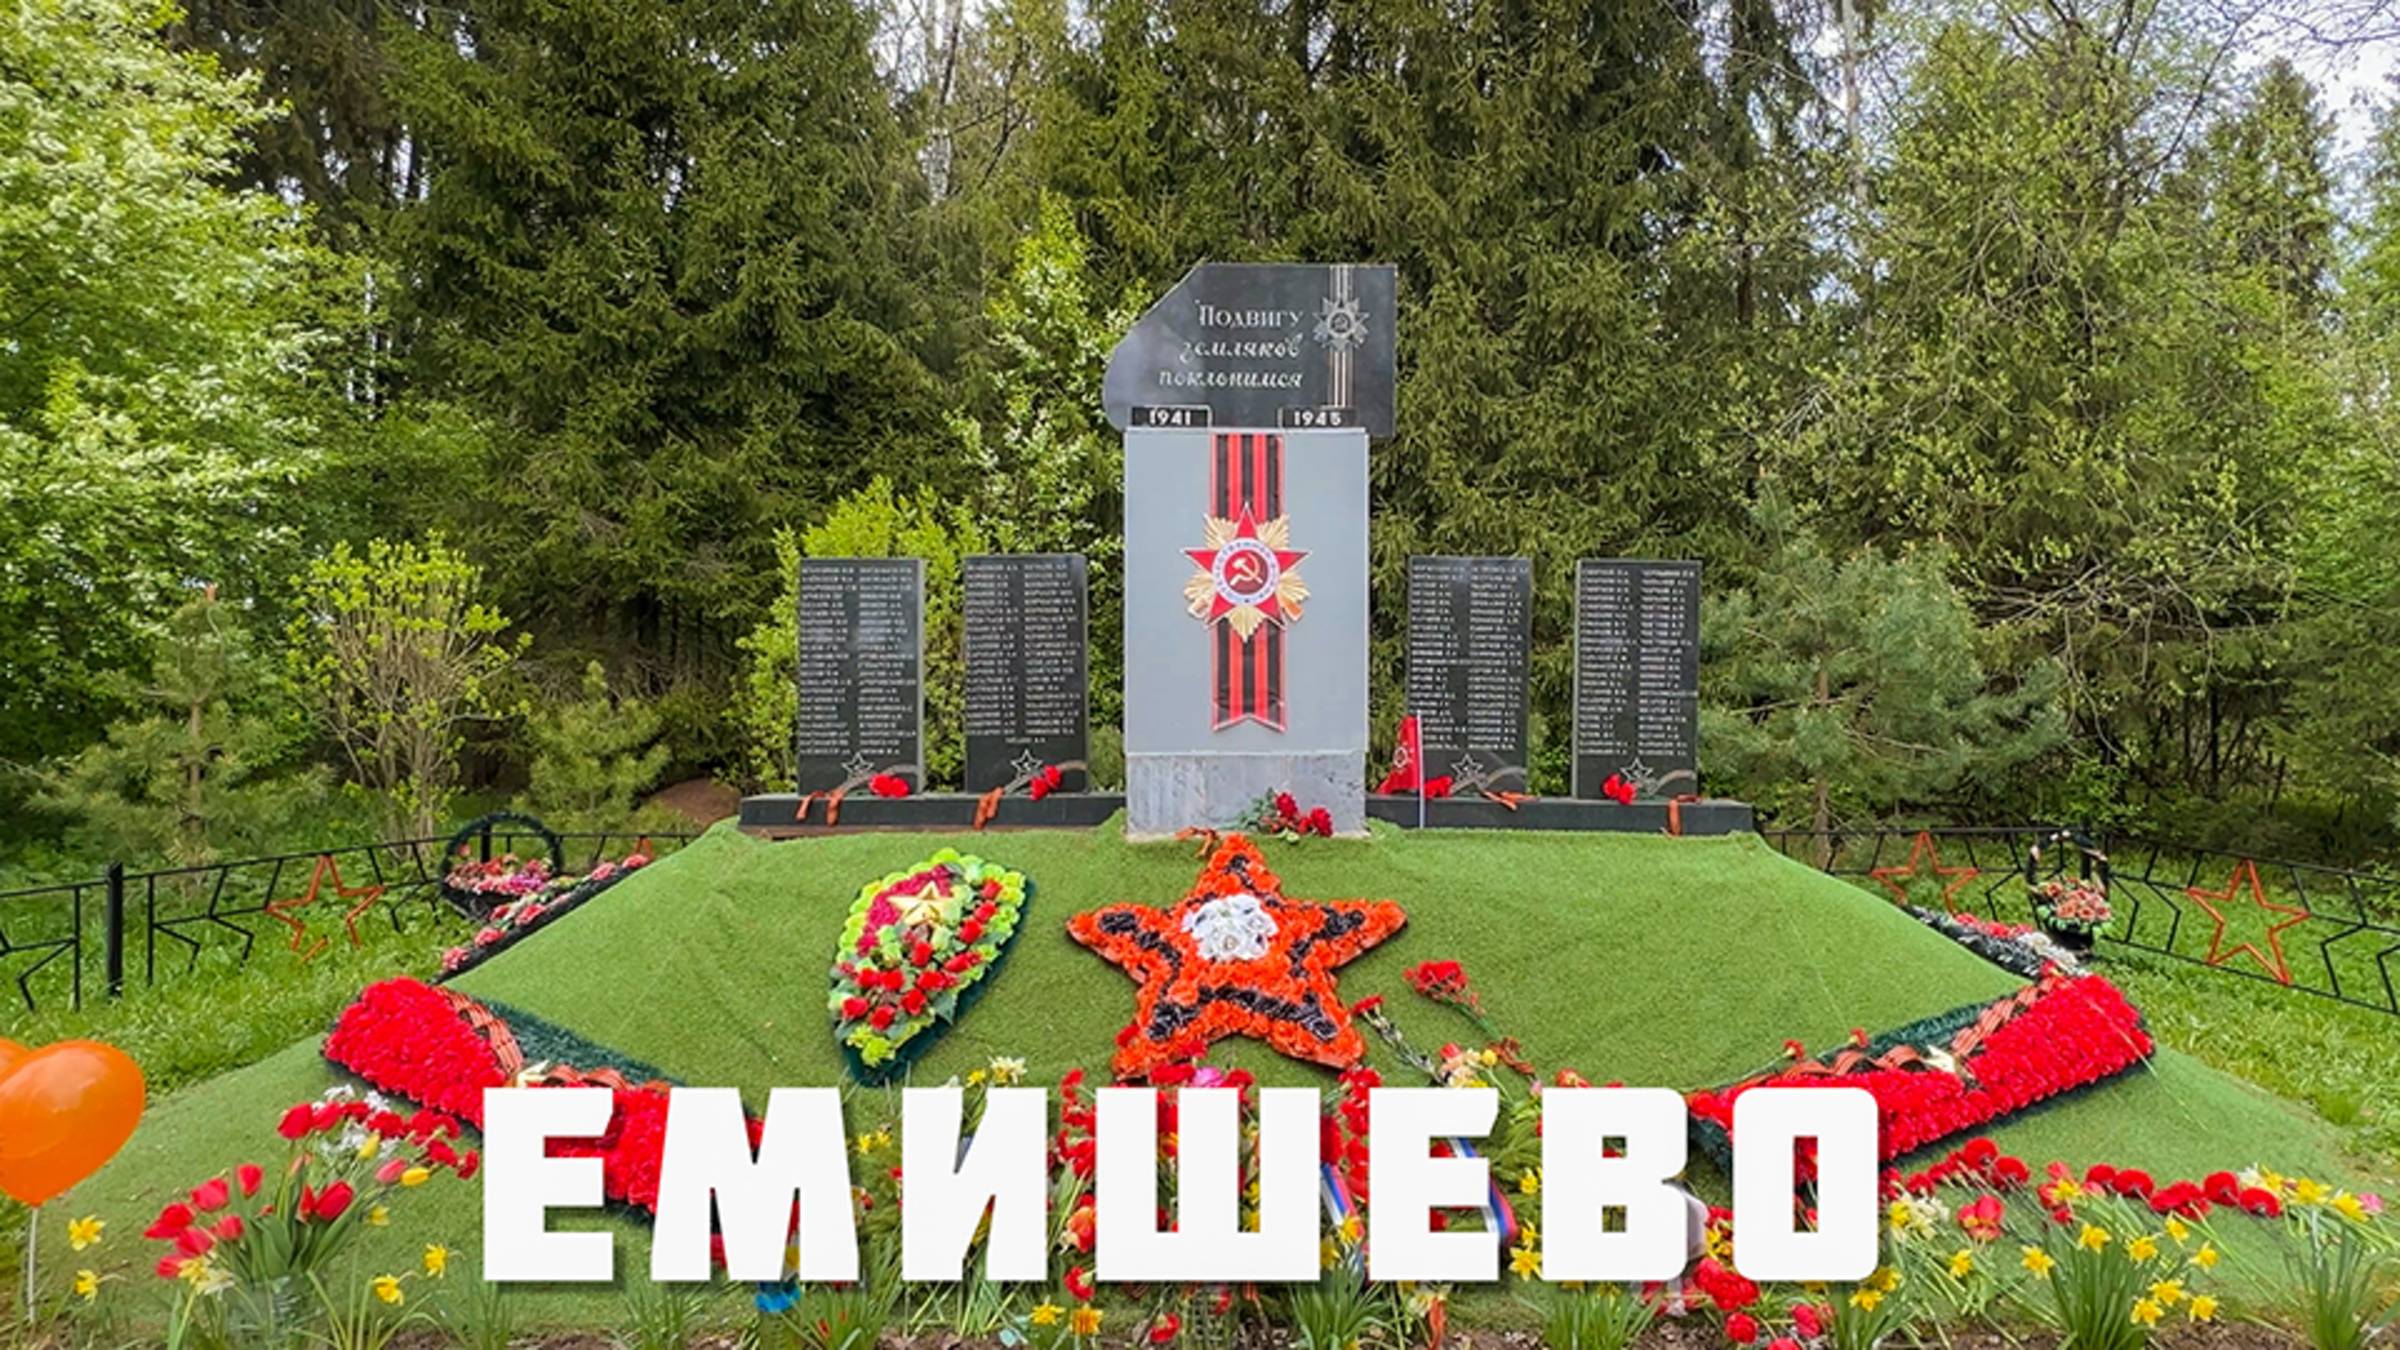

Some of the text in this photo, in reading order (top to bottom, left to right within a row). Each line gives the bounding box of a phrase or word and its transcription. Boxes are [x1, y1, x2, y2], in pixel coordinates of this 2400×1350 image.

[1179, 333, 1304, 364] земляков
[1158, 371, 1303, 388] поклонимся
[1149, 410, 1192, 426] 1941
[1294, 410, 1342, 426] 1945
